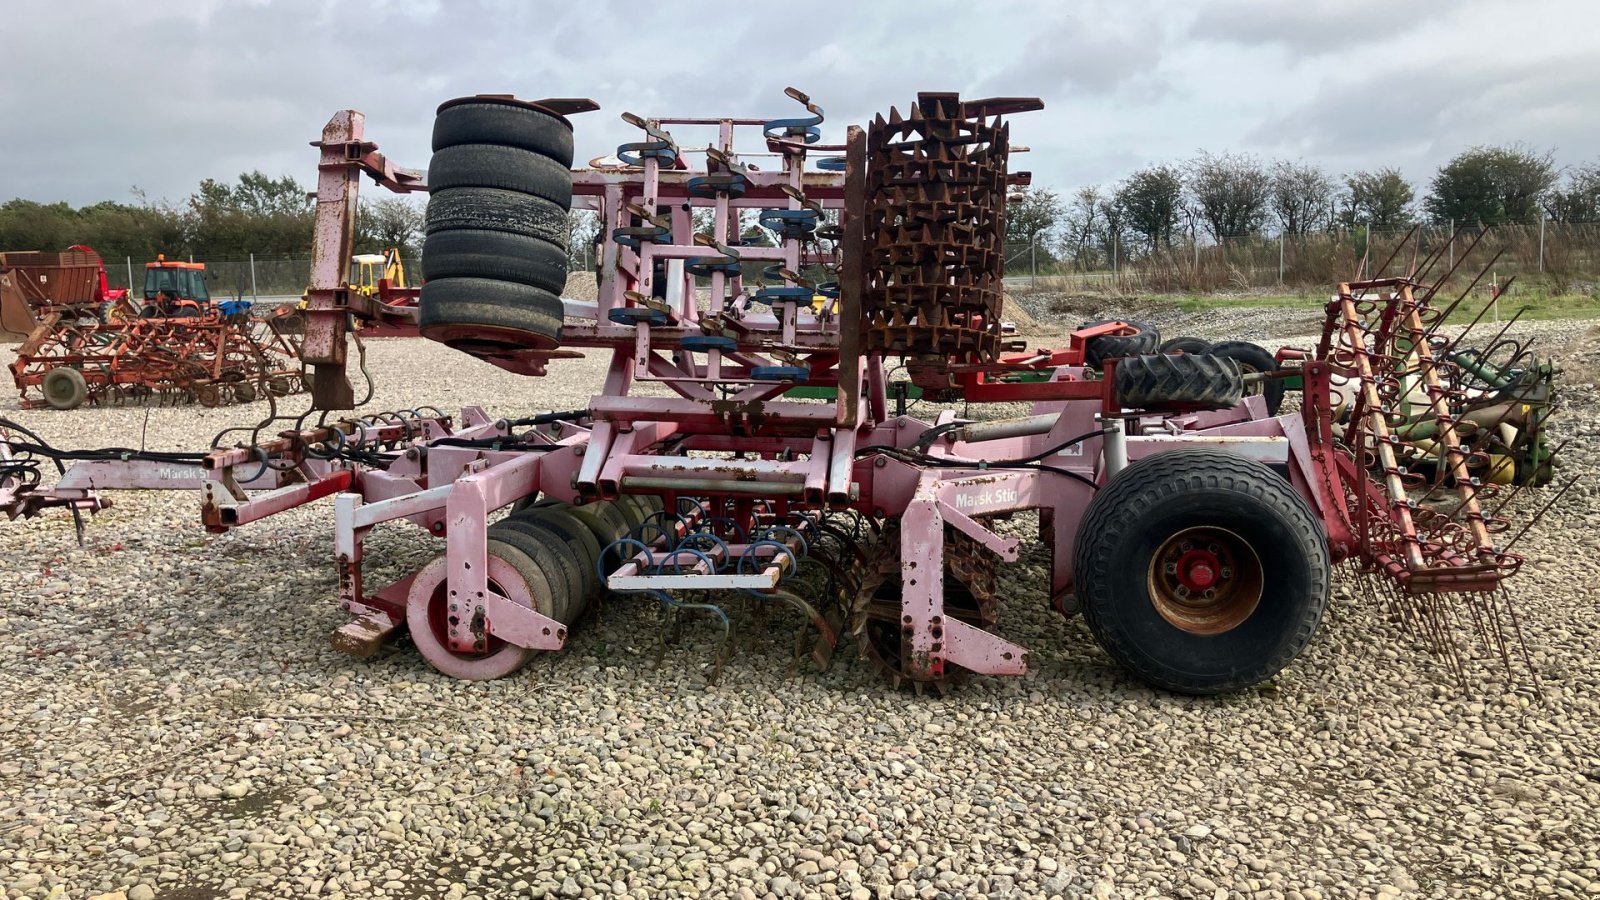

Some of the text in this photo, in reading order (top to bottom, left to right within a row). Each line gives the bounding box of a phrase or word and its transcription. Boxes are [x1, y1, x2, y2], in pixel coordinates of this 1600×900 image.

[160, 468, 197, 479] Marsk
[955, 488, 1017, 508] Marsk Stig
